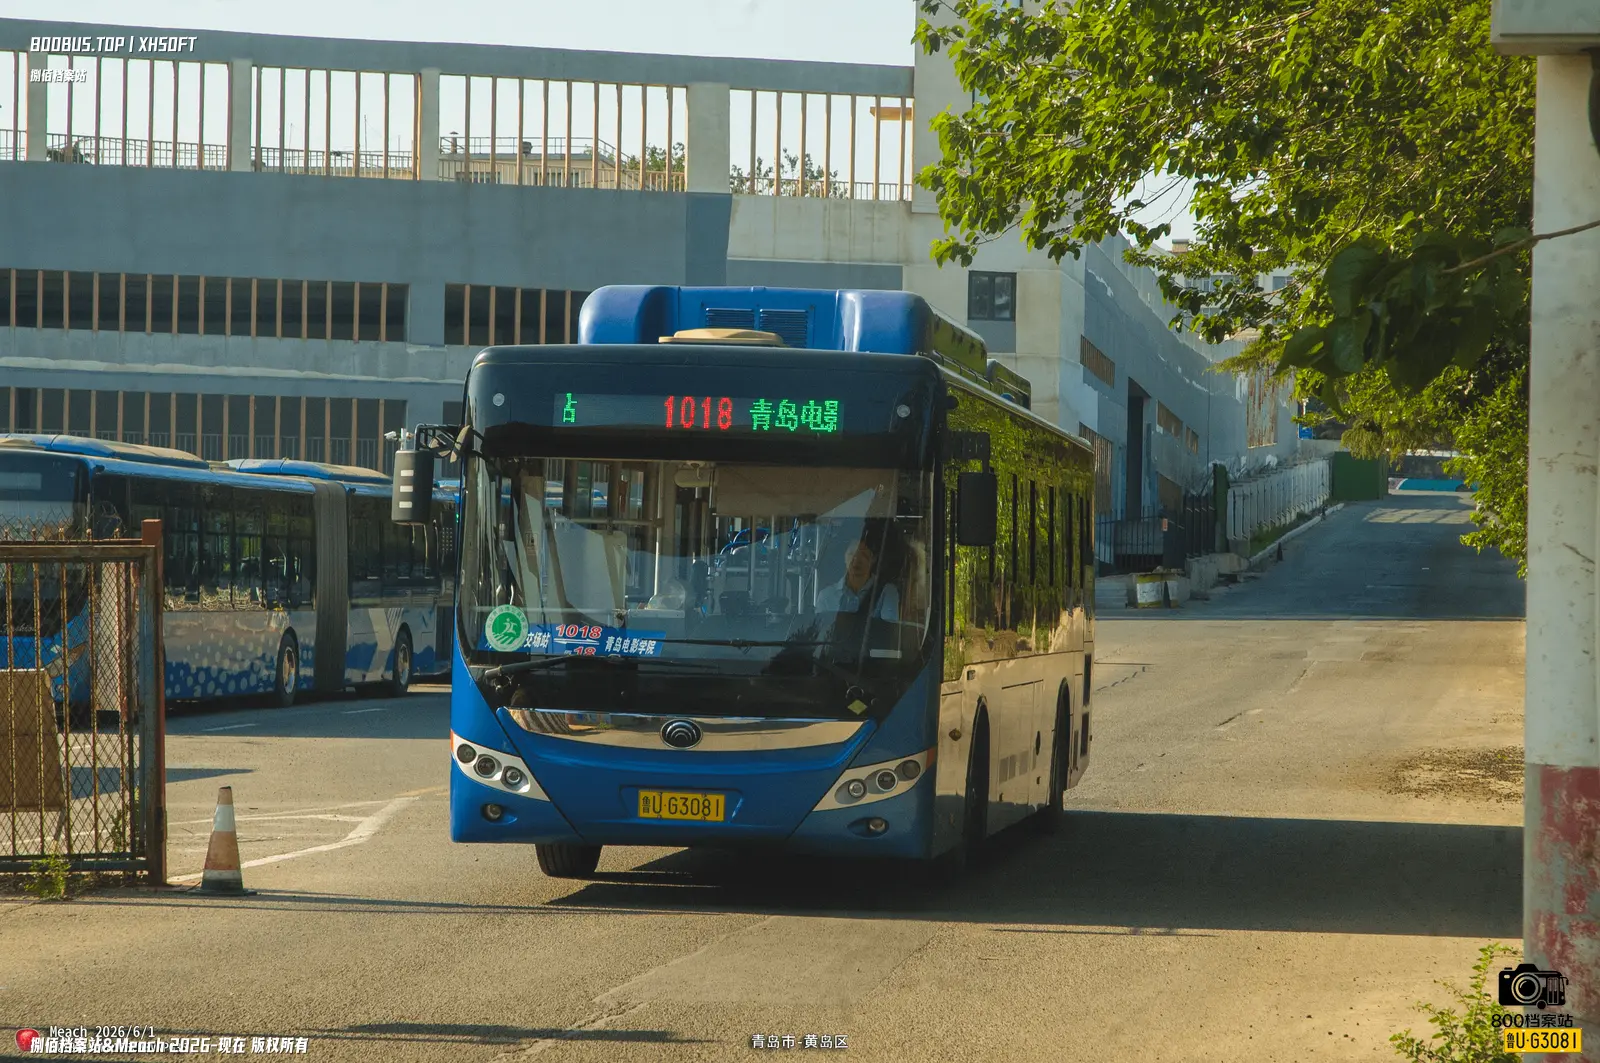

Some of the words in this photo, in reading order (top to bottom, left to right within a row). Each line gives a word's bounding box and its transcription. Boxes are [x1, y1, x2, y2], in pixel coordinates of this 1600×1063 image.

[664, 396, 733, 430] 1018
[555, 623, 603, 639] 1018
[604, 636, 657, 655] 青岛电影学院
